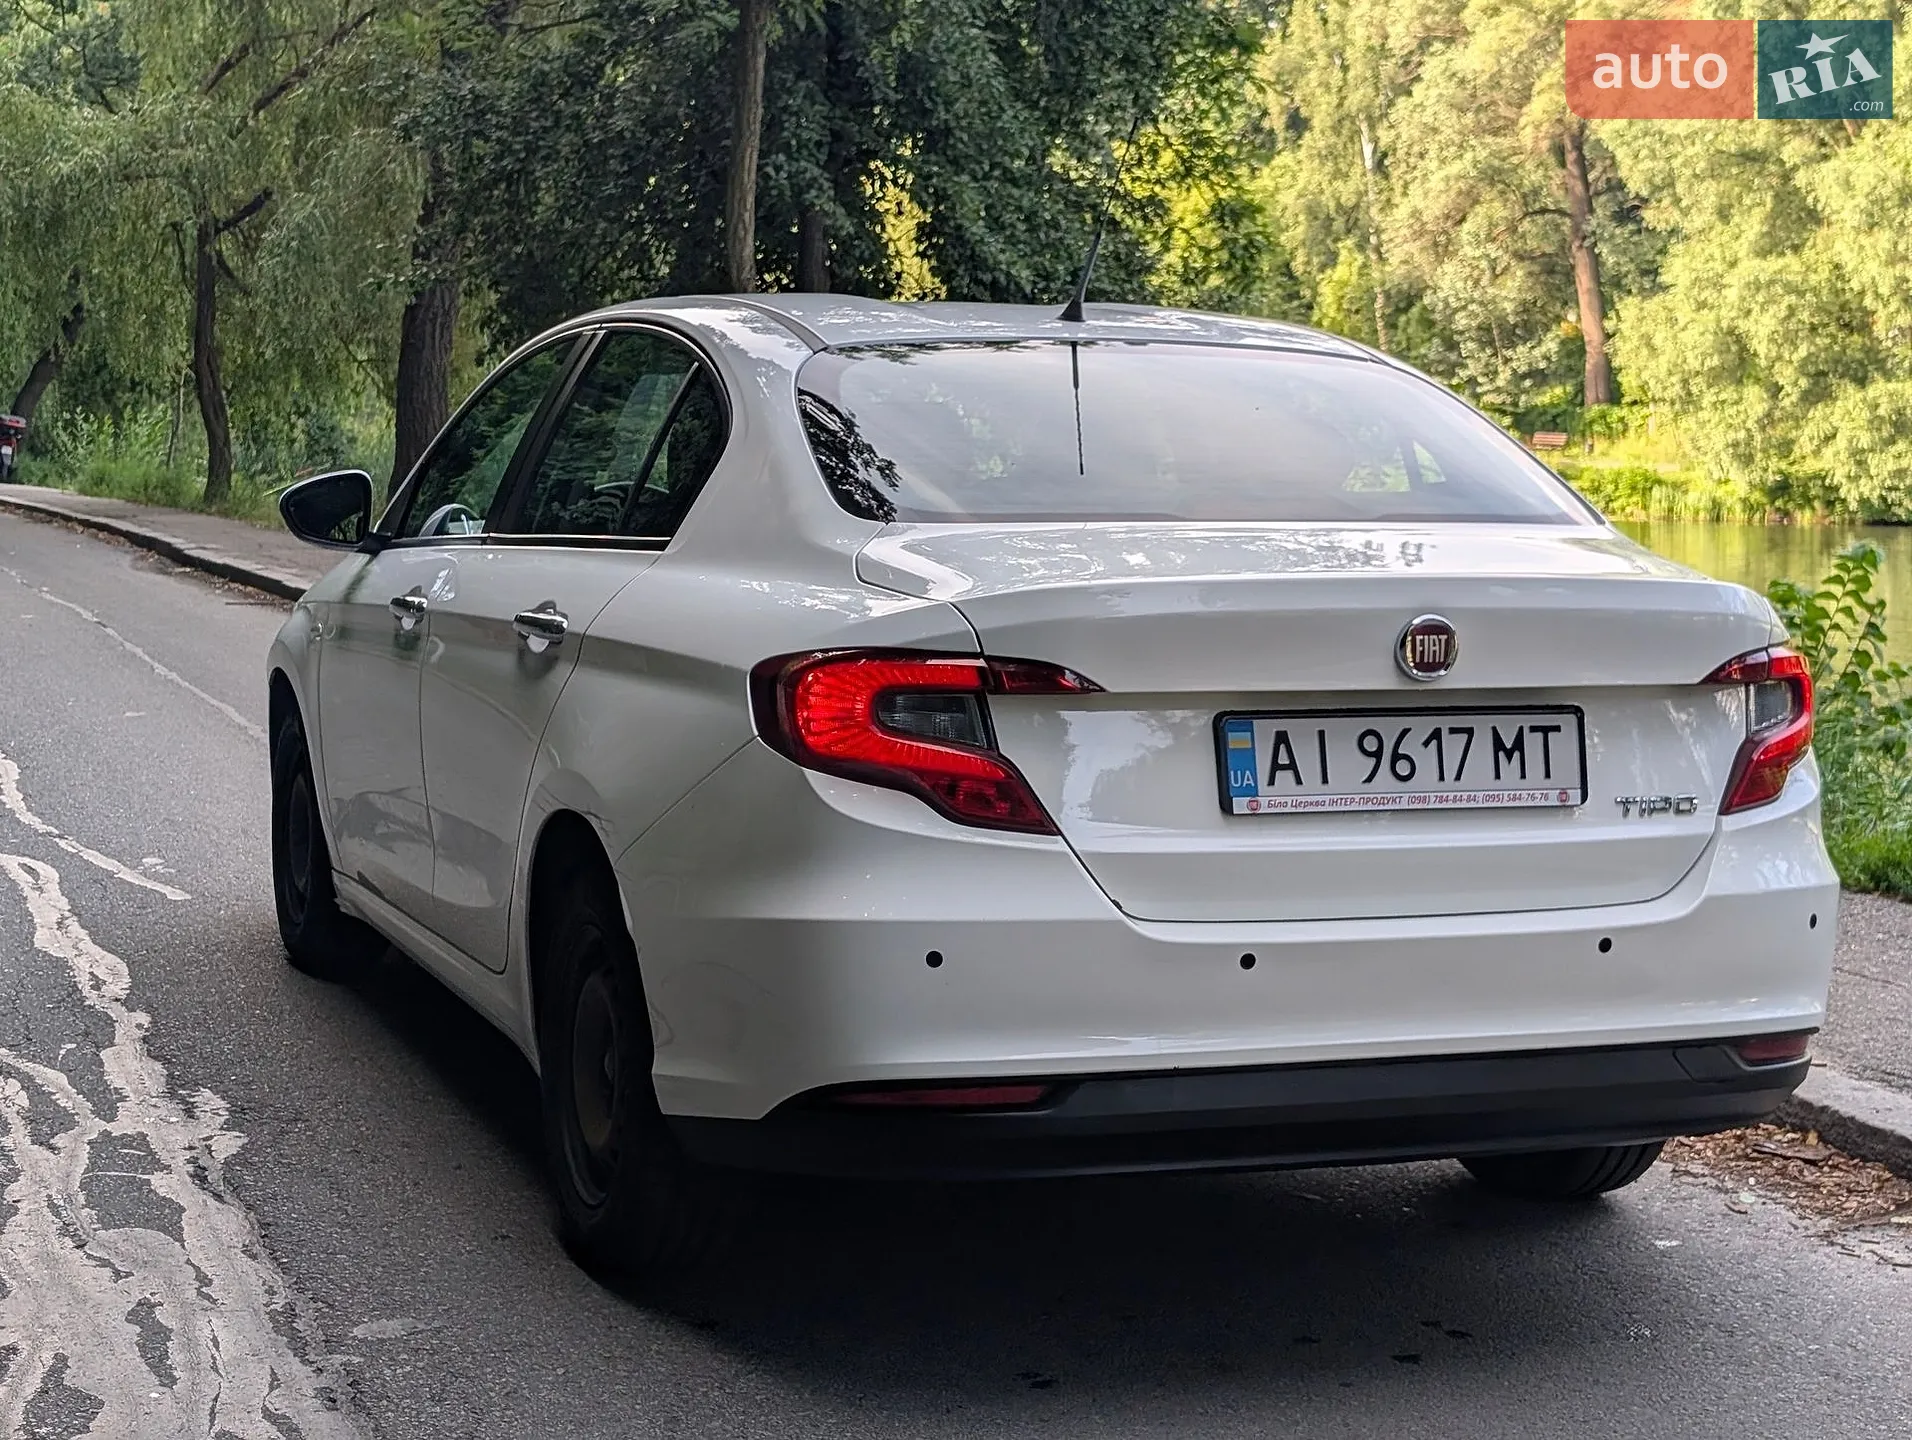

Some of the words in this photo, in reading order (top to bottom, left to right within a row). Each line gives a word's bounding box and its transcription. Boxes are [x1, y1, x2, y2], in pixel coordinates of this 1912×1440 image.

[1415, 634, 1448, 663] FIAT
[1267, 729, 1329, 786] AI
[1357, 726, 1475, 784] 9617
[1491, 724, 1562, 781] MT
[1230, 770, 1255, 788] UA
[1267, 799, 1288, 809] Біла
[1291, 799, 1326, 810] Церква
[1328, 795, 1403, 807] ІНТЕР-ПРОДУКТ
[1407, 795, 1431, 806] (098)
[1482, 792, 1504, 804] (095)
[1507, 791, 1549, 803] 584-76-76
[1614, 794, 1699, 818] TIPO
